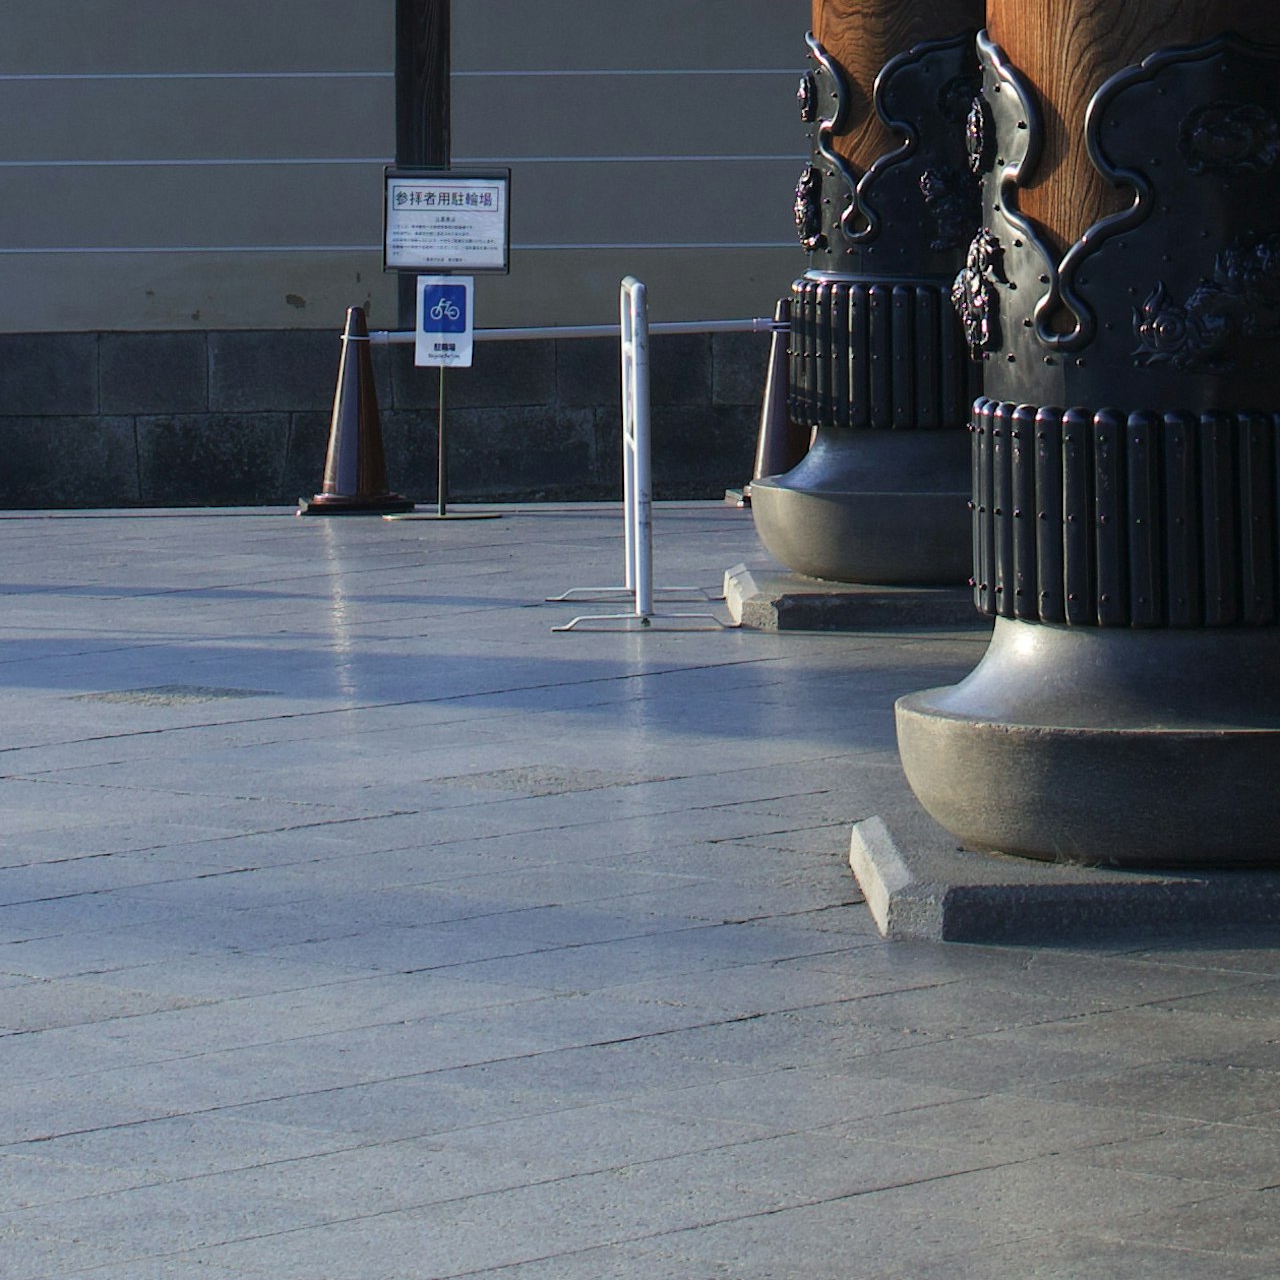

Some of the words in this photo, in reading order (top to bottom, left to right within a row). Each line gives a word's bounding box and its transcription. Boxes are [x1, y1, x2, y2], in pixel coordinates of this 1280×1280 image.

[395, 190, 493, 207] 参拝者用駐輪場
